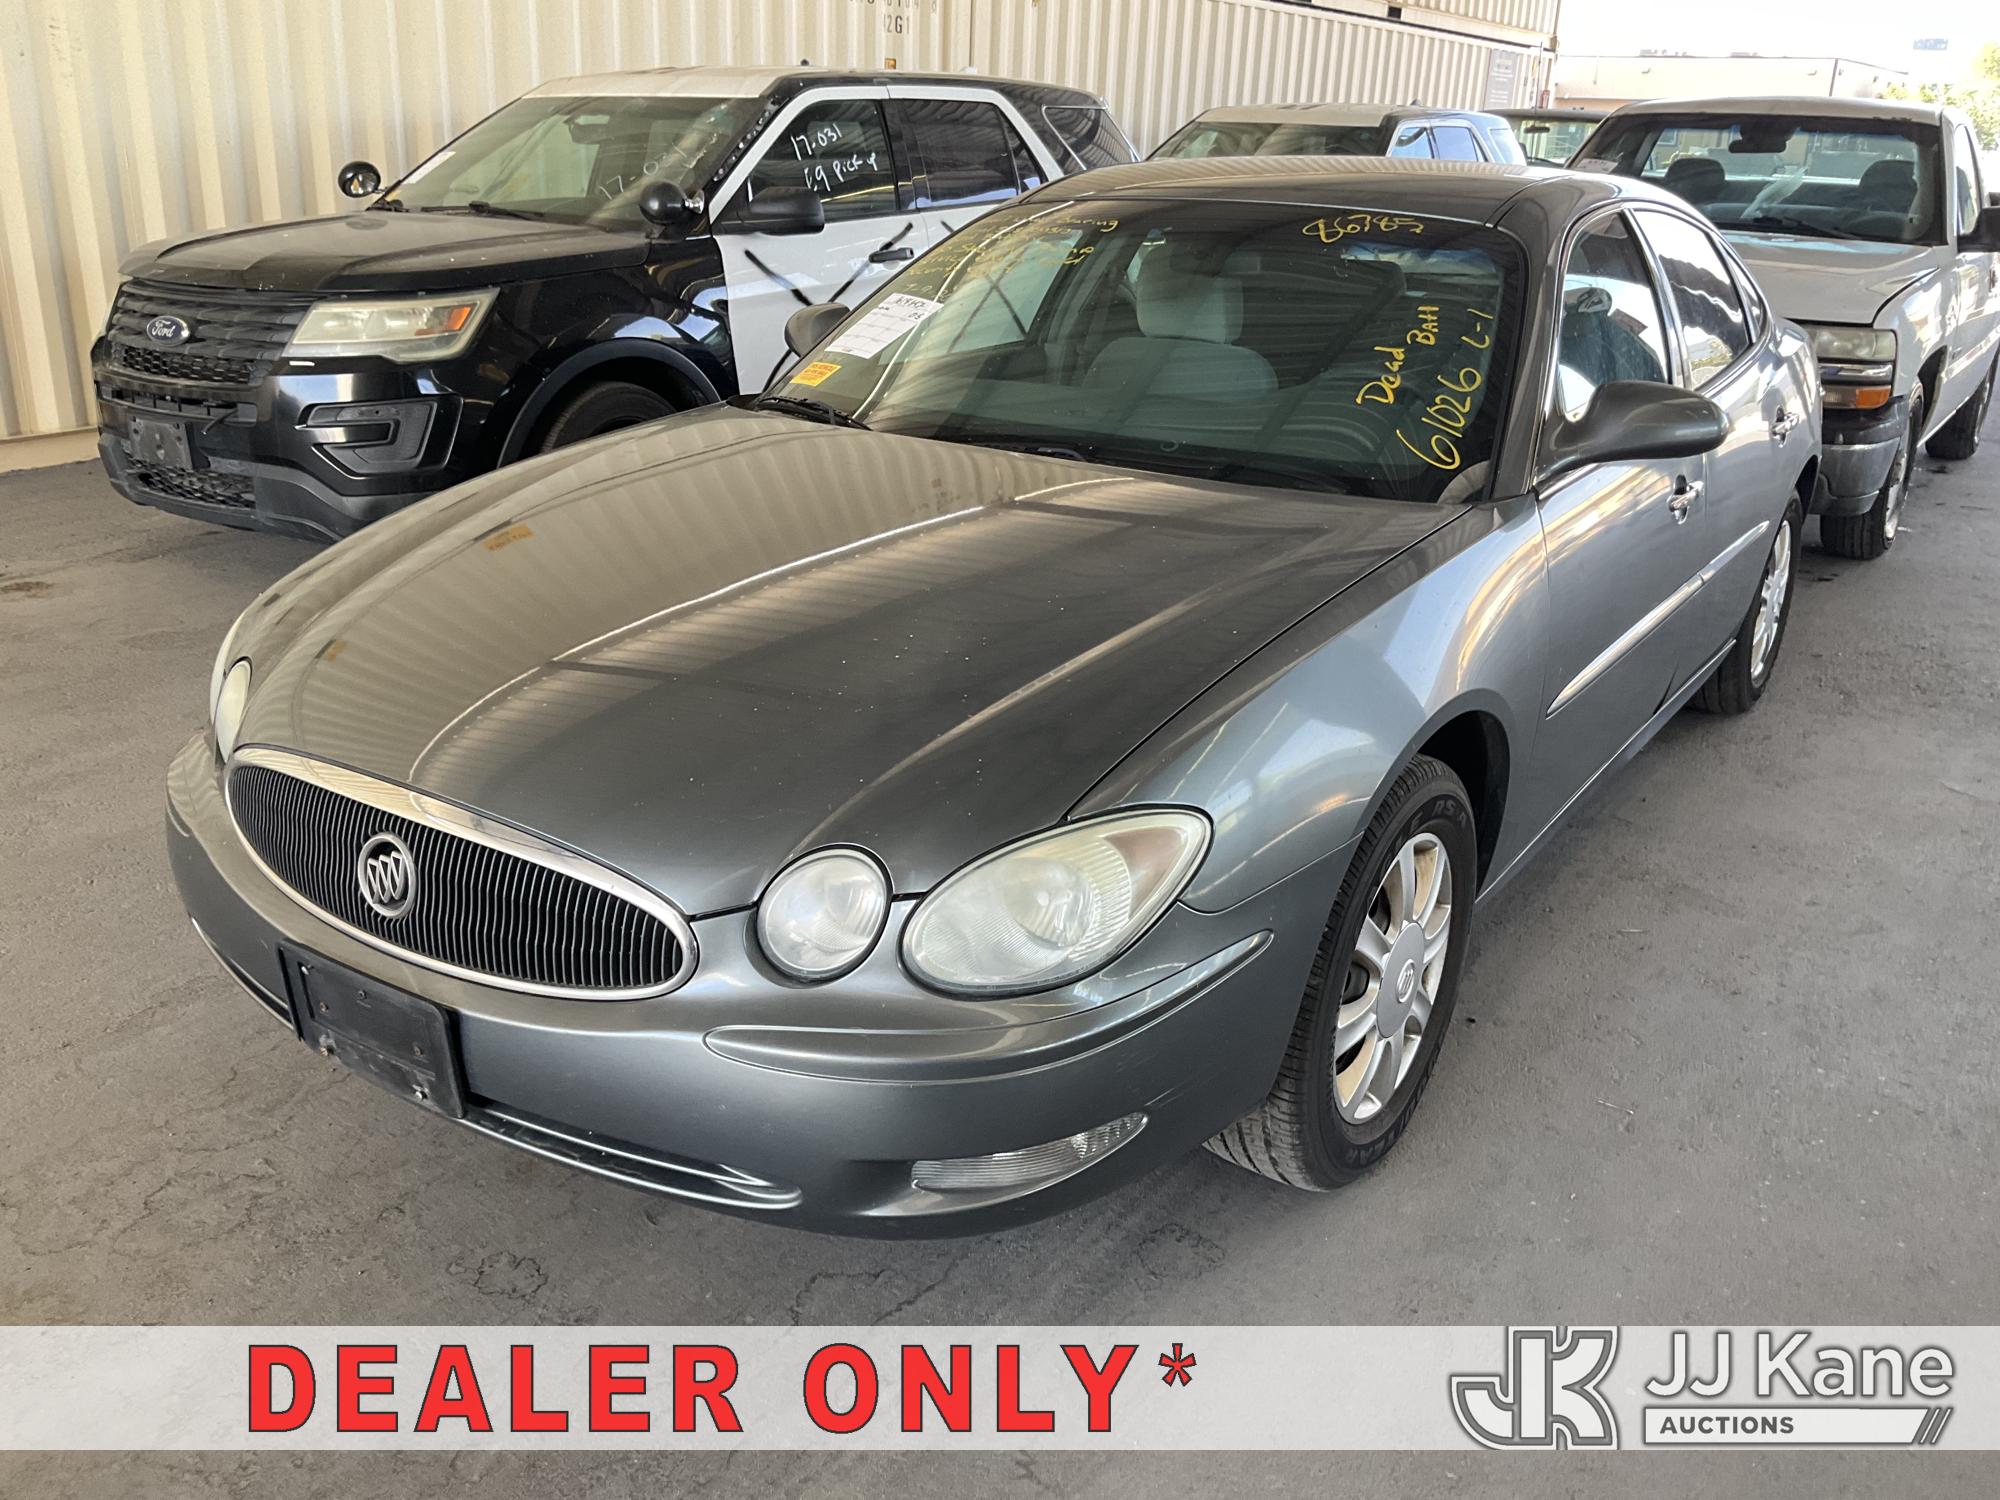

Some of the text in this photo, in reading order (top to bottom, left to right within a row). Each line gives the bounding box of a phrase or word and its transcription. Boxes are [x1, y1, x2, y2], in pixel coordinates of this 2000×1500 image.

[151, 319, 176, 337] Ford
[1355, 346, 1406, 405] Dead
[1396, 367, 1482, 470] 61026
